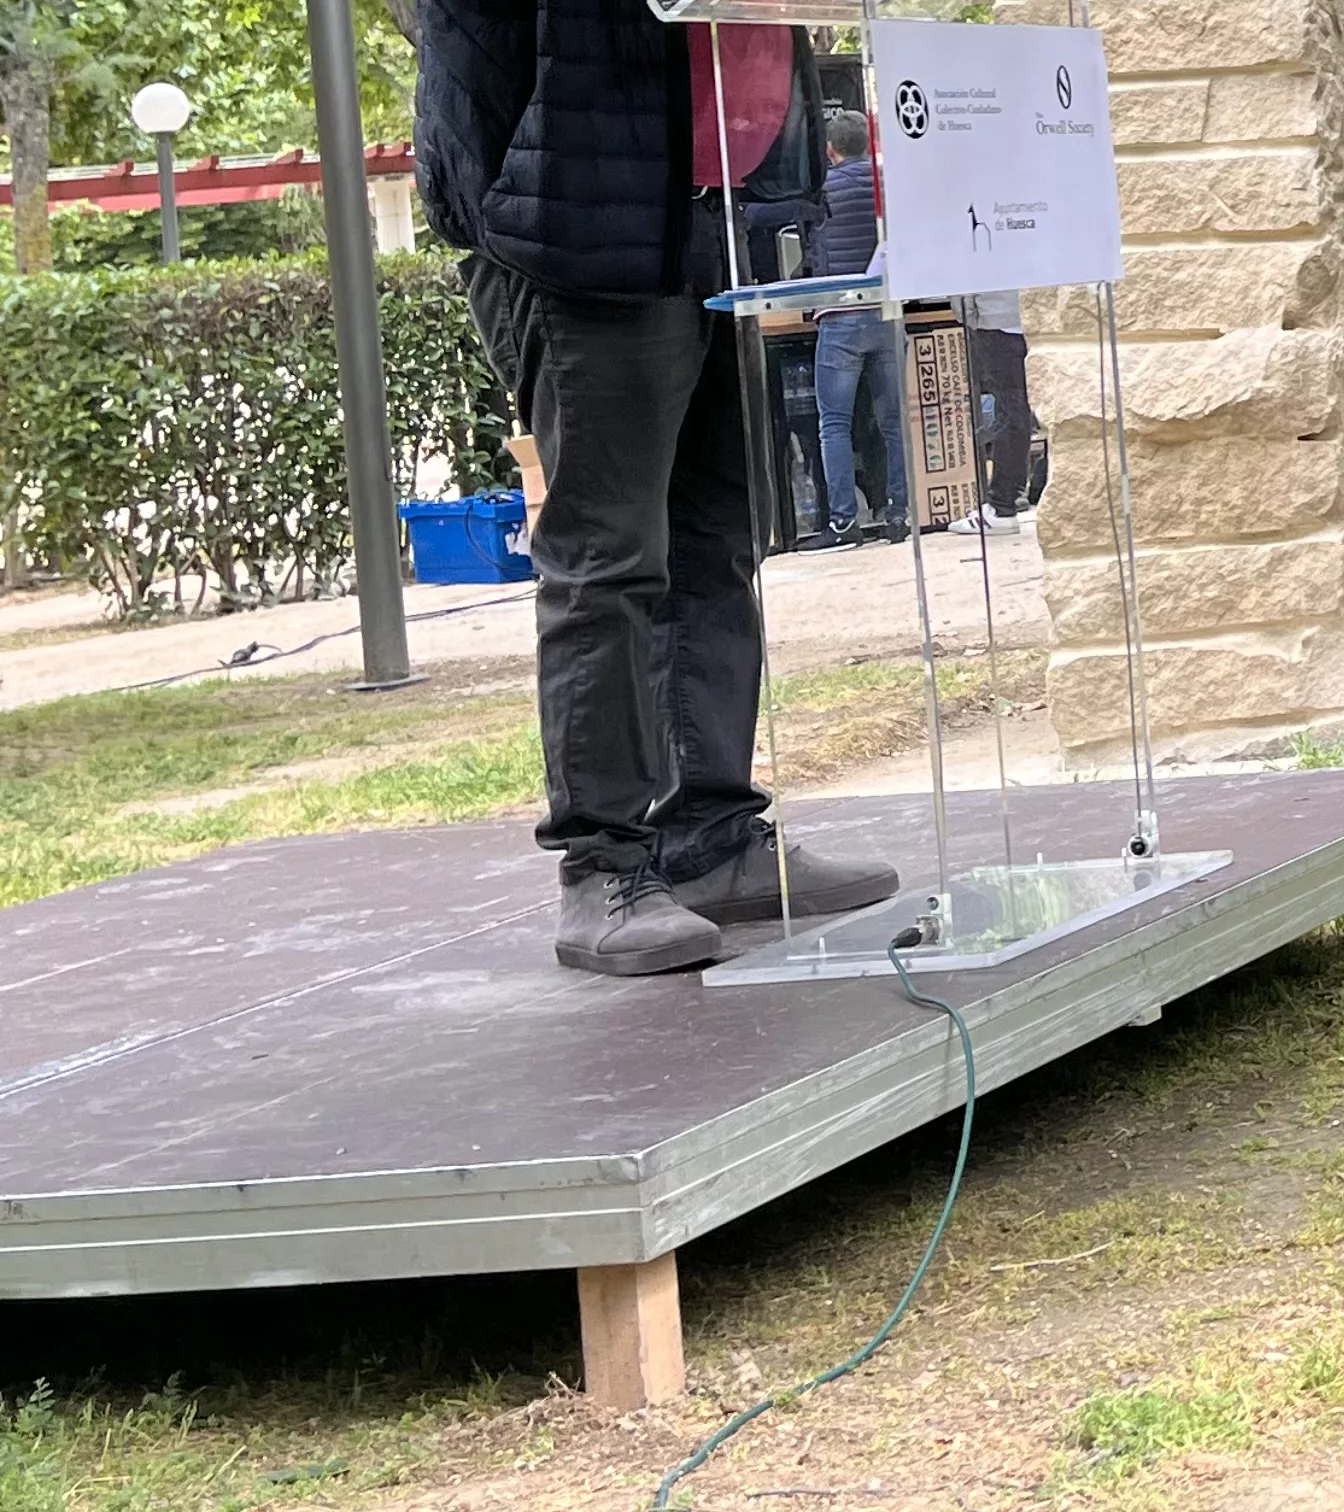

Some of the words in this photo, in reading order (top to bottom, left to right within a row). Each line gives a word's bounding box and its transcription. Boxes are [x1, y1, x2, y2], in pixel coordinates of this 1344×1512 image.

[1036, 120, 1067, 135] Orwell
[1068, 119, 1095, 138] Society
[1006, 217, 1036, 230] Huesca
[919, 345, 932, 356] 3
[920, 366, 937, 402] 265
[941, 375, 951, 389] 70
[947, 333, 960, 374] EXCELSO
[955, 414, 968, 467] COLOMBIA
[943, 406, 953, 428] Net
[932, 495, 945, 508] 3
